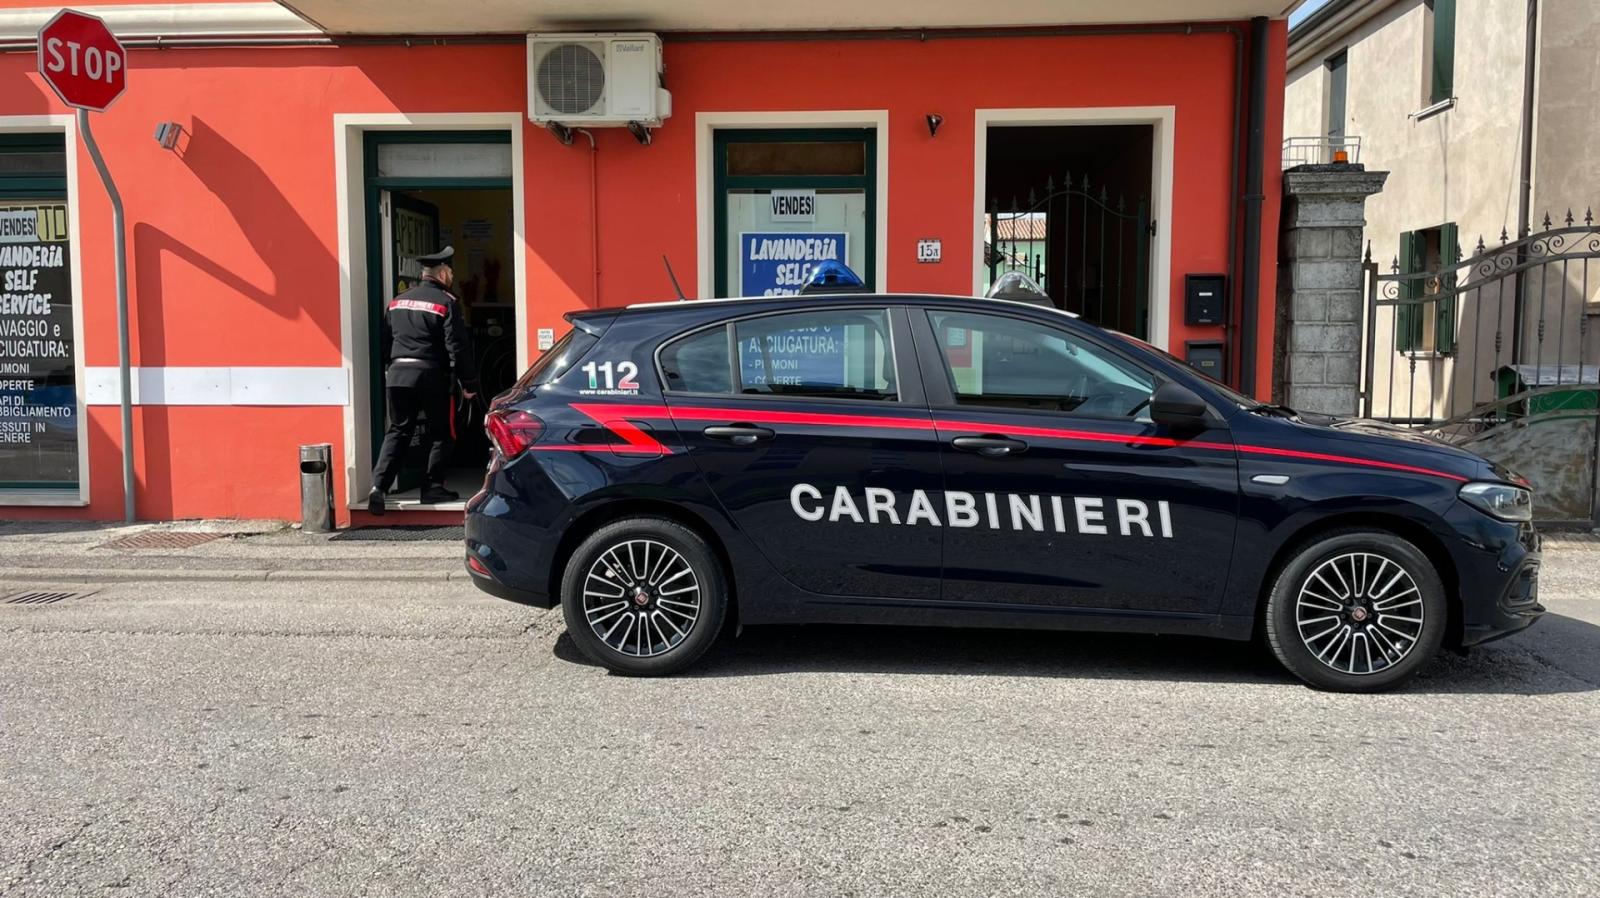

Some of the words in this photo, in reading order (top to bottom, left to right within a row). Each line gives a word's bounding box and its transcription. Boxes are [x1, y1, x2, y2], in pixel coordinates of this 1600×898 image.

[47, 37, 121, 84] STOP
[772, 196, 815, 215] VENDESI
[4, 269, 38, 291] SELF
[776, 262, 811, 286] SELF
[53, 323, 61, 337] e
[755, 359, 798, 369] PIMONI
[582, 361, 640, 389] 112
[14, 396, 24, 406] DI
[0, 422, 31, 432] SSUTI
[36, 422, 46, 432] IN
[790, 483, 1174, 539] CARABINIERI
